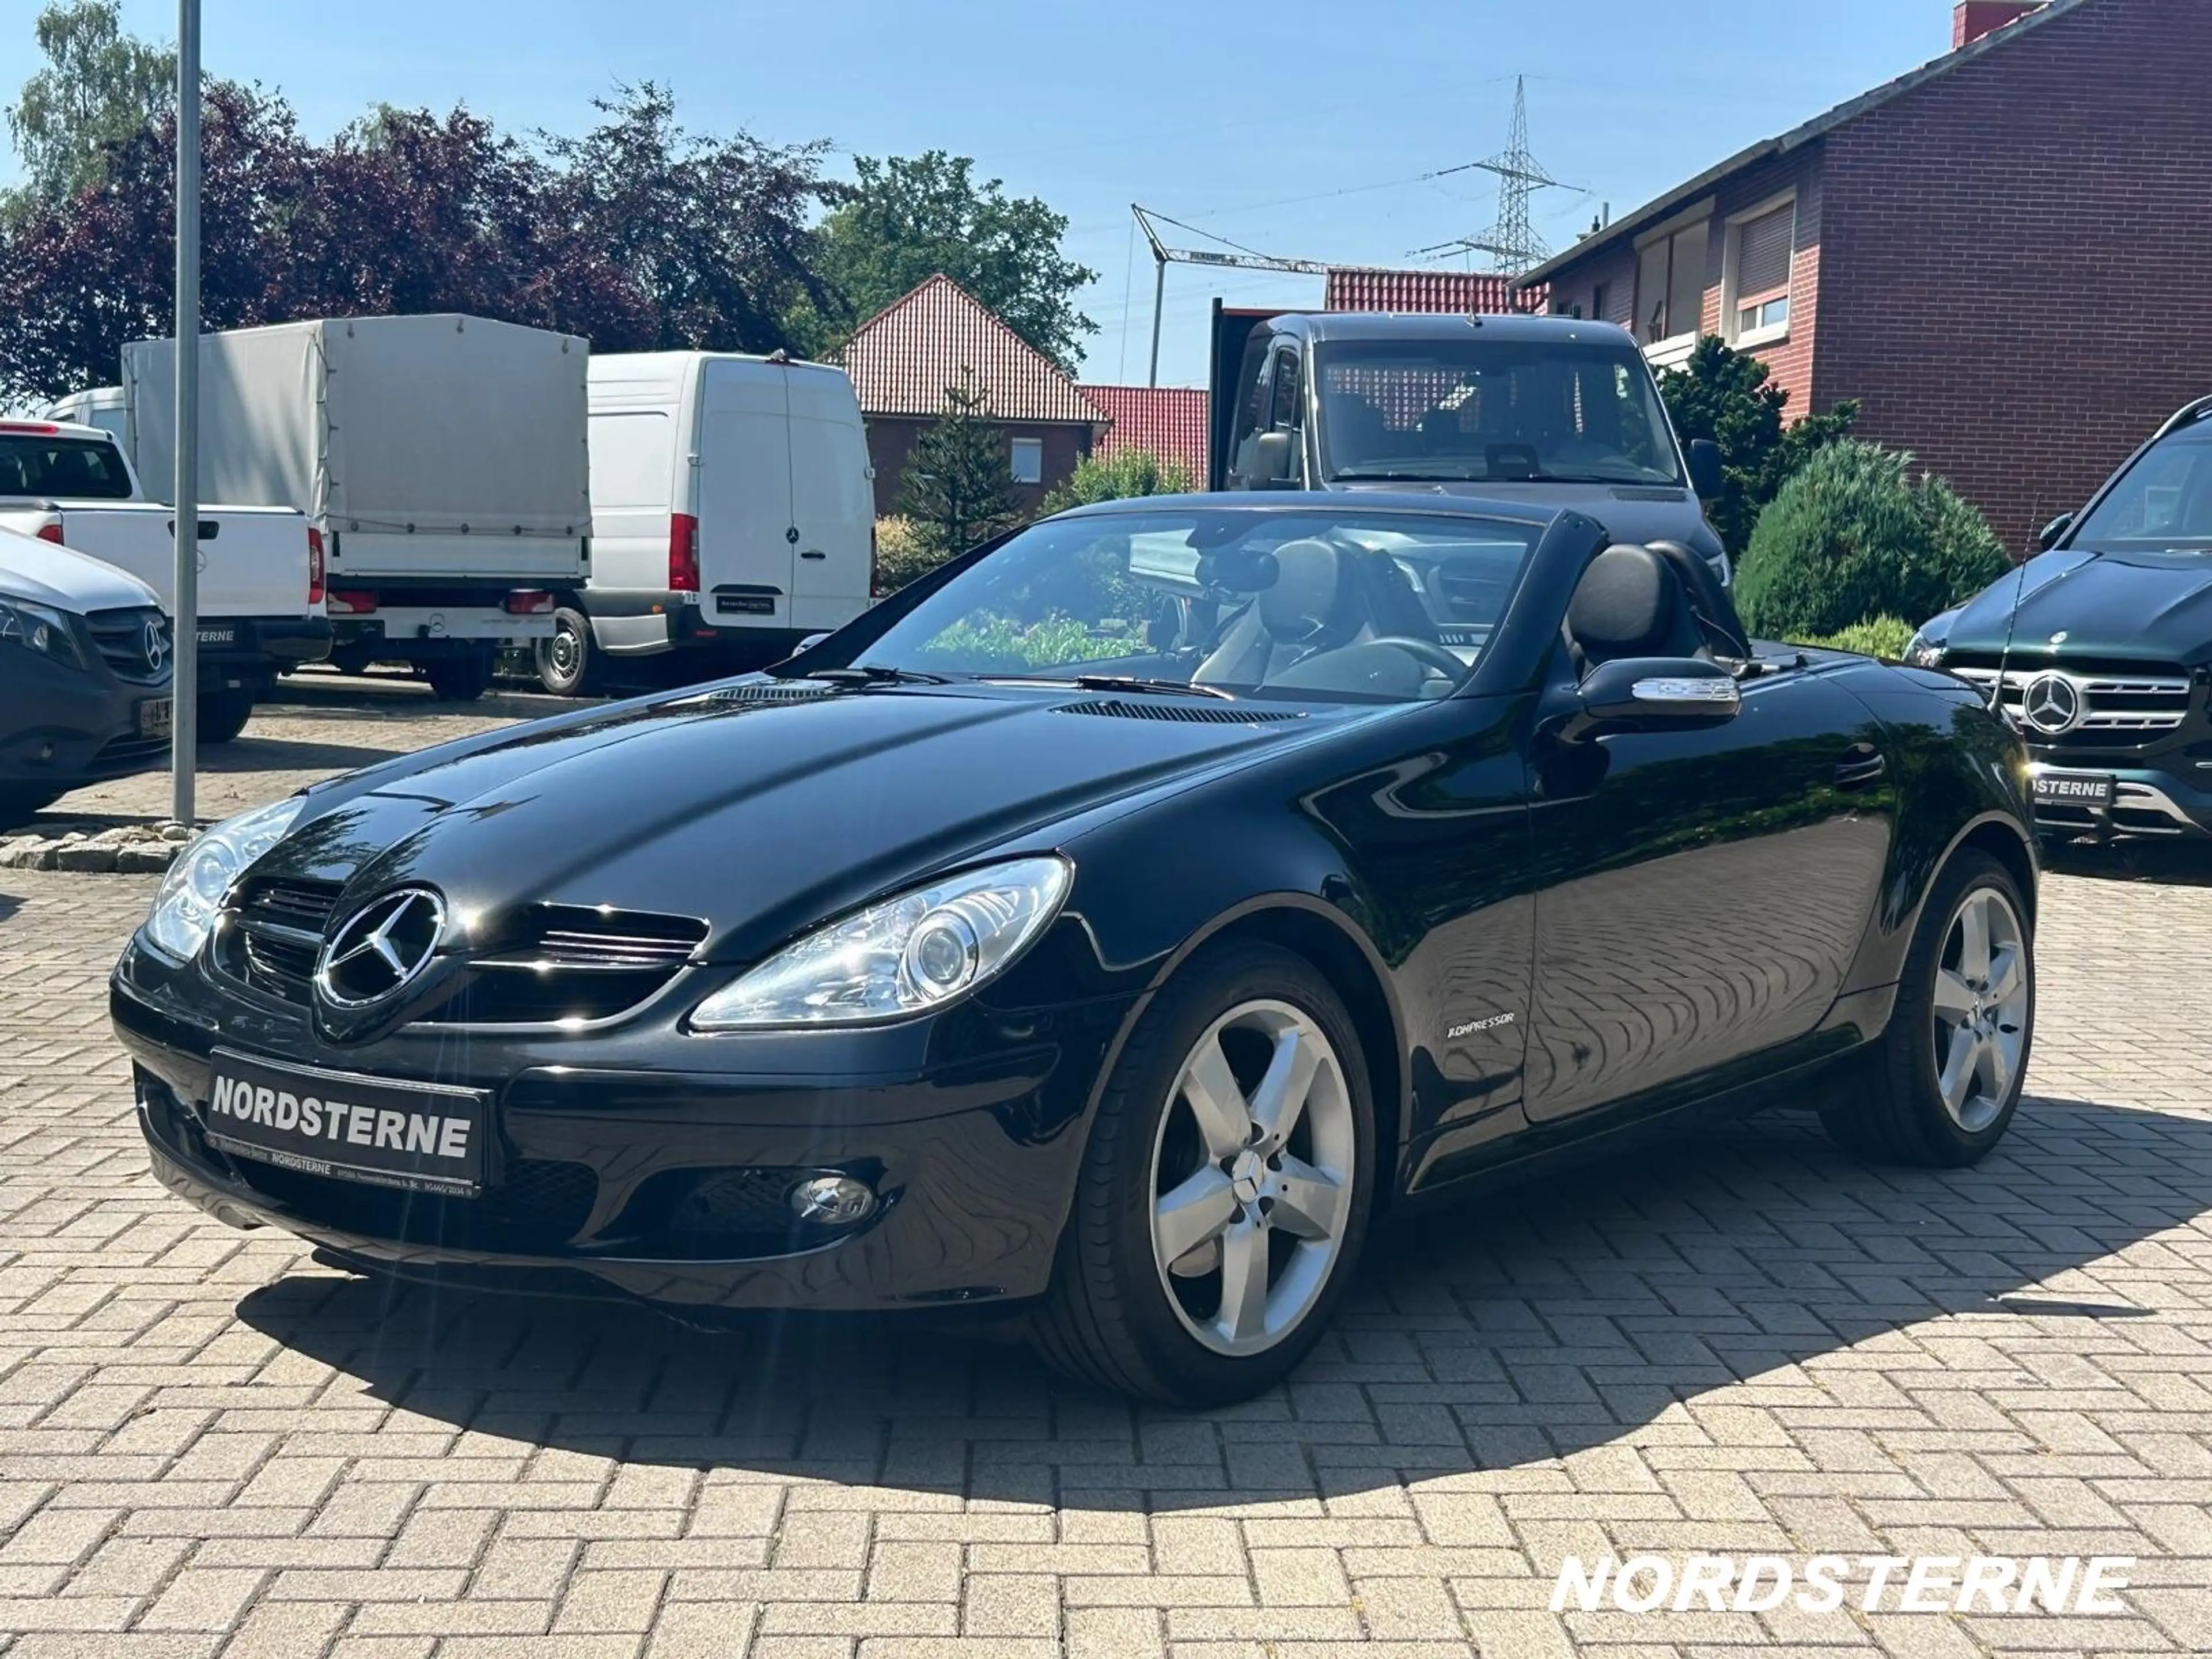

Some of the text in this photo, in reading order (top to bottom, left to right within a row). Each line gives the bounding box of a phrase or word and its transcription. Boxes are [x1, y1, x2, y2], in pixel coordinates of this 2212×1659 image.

[196, 630, 234, 642] TERNE
[2032, 779, 2107, 797] STERNE
[1447, 1012, 1515, 1039] KOMPRESSOR
[211, 1075, 471, 1158] NORDSTERNE
[272, 1153, 331, 1175] NORDSTERNE
